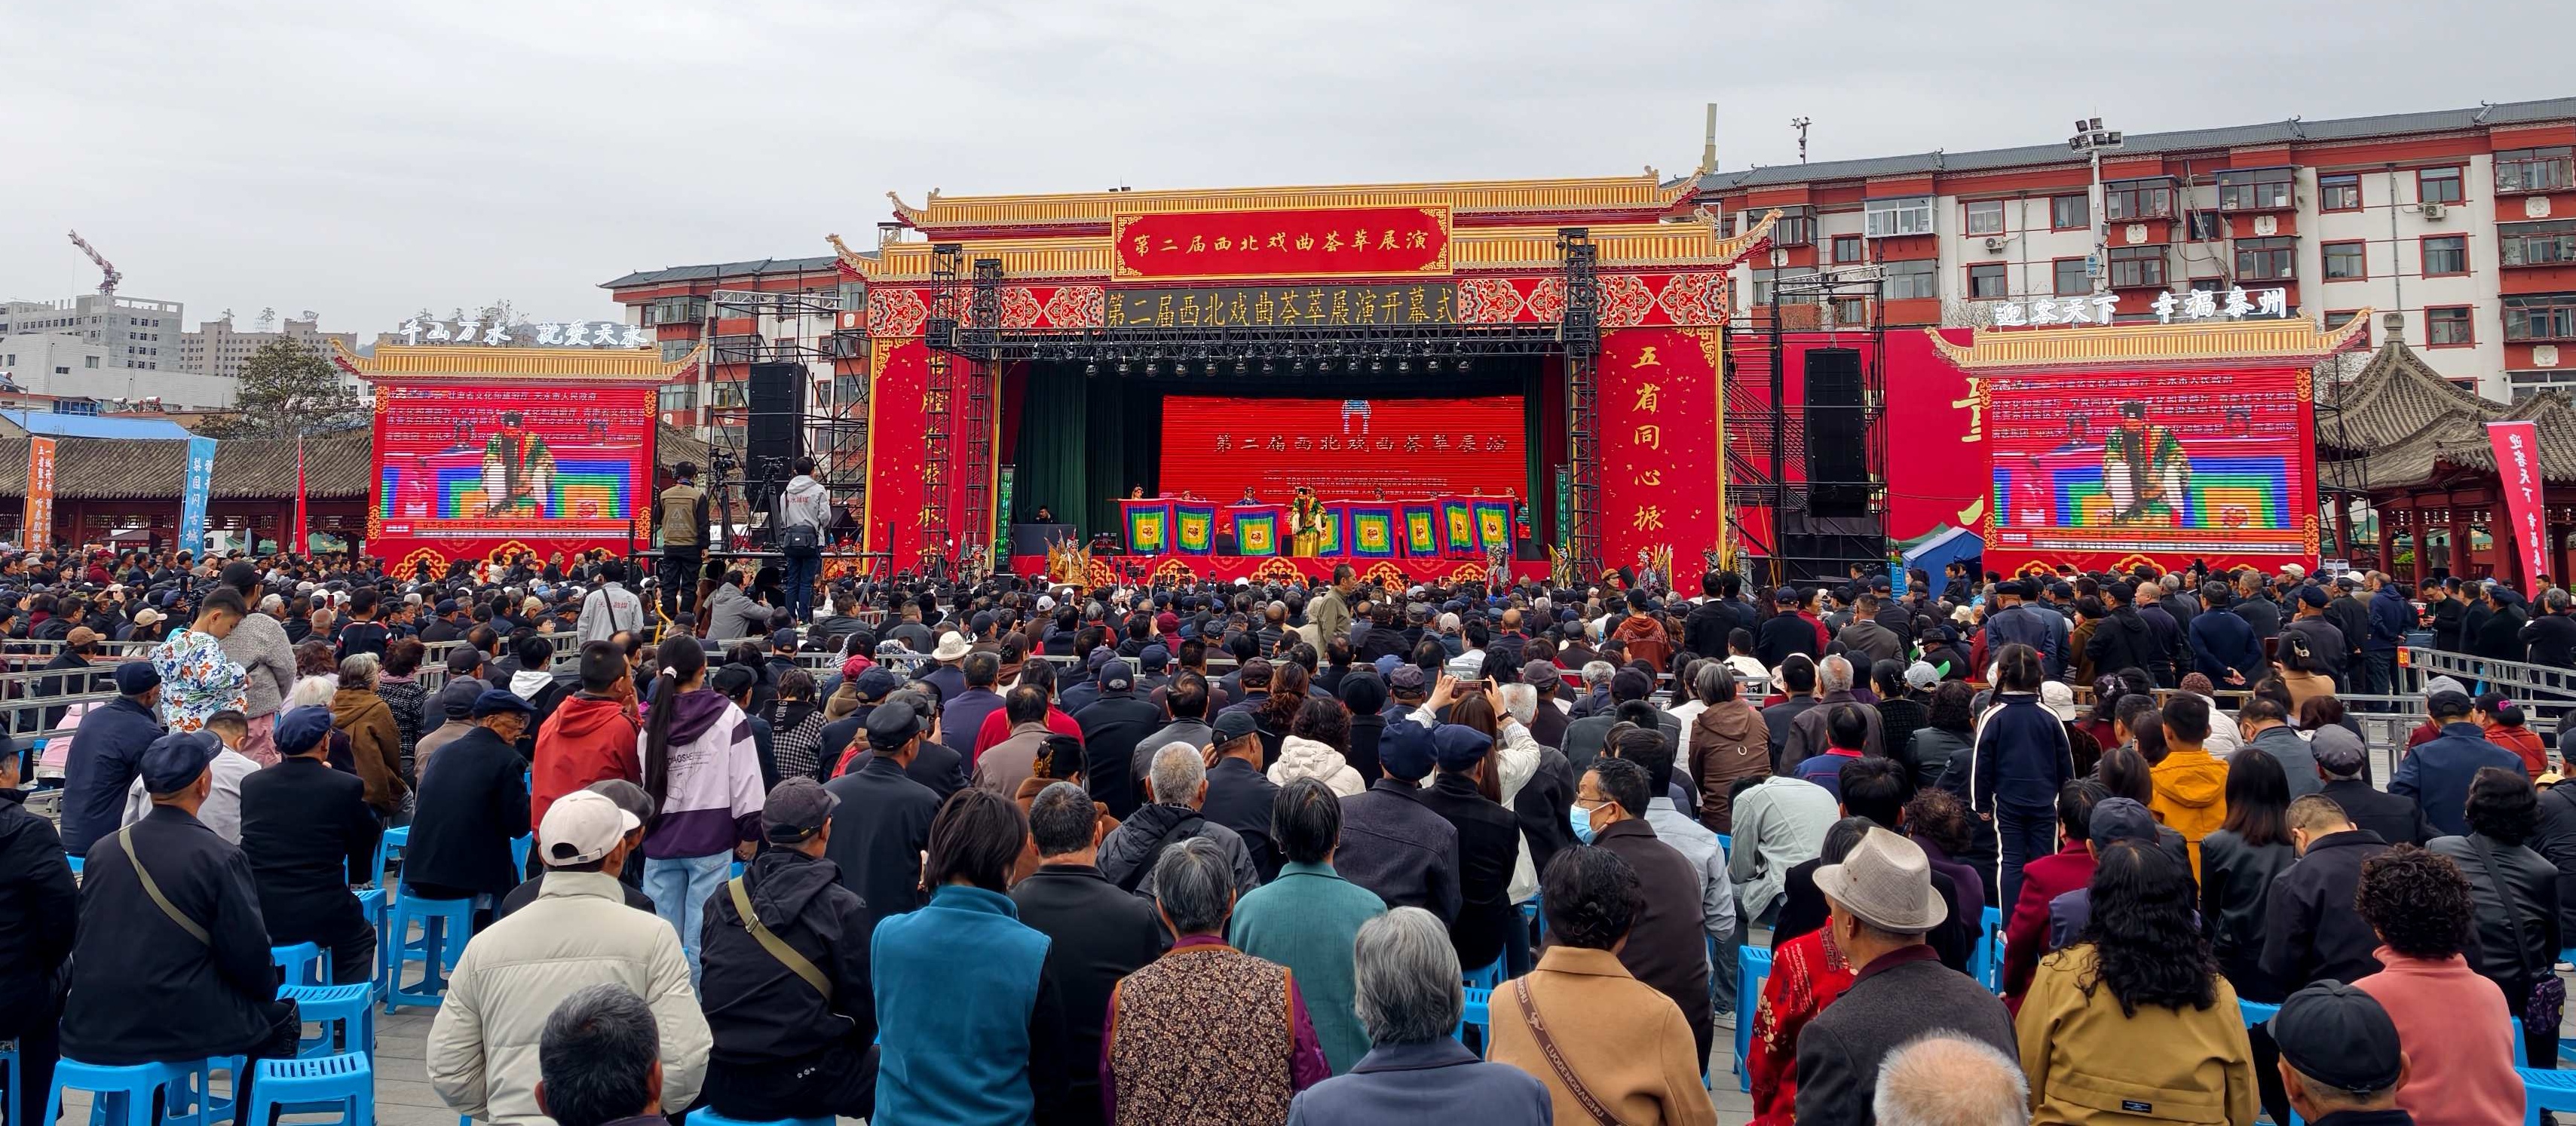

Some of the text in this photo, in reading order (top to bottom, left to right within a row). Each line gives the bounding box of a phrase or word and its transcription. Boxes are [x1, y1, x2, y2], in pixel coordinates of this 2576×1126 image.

[1133, 229, 1429, 257] 第二届西北戏曲荟萃展演
[1106, 286, 1456, 327] 第二届西北戏曲荟萃展演开幕式
[1996, 295, 2120, 327] 迎客天下
[400, 318, 648, 348] 千山万水 就爱天水
[1631, 346, 1664, 532] 五省同心振
[1545, 1044, 1604, 1118] LUODENGDAISHU
